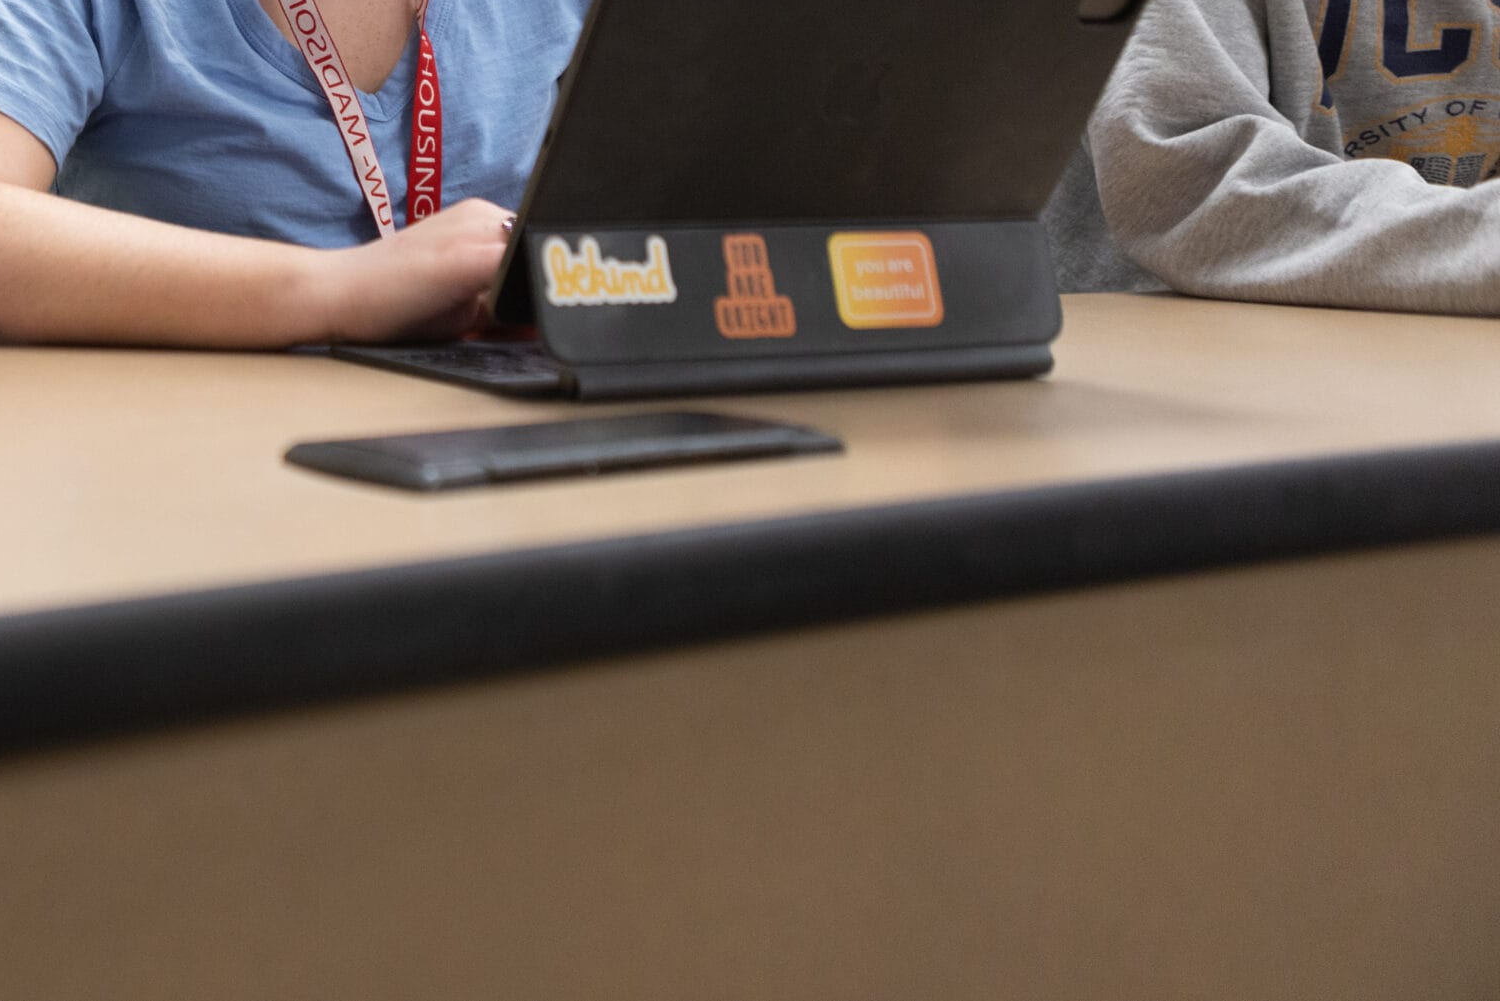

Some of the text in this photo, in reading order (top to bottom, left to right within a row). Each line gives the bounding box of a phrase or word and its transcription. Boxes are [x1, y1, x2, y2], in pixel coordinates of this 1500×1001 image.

[1445, 99, 1488, 117] OF
[414, 53, 436, 220] HOUSING
[854, 257, 916, 279] you are
[851, 284, 926, 301] beautiful
